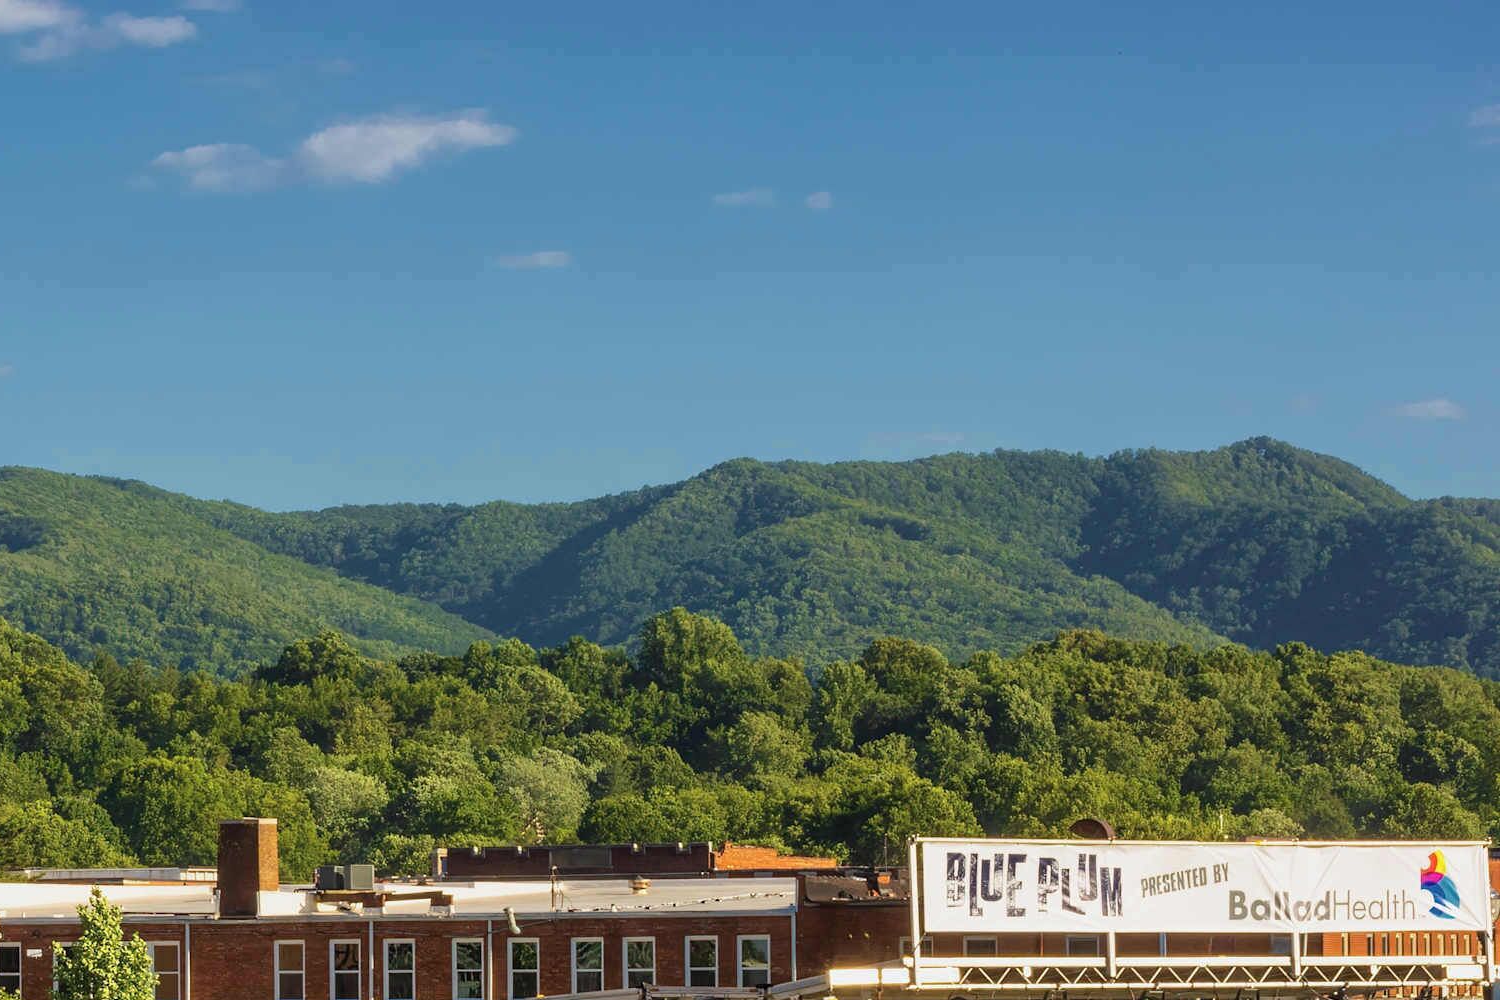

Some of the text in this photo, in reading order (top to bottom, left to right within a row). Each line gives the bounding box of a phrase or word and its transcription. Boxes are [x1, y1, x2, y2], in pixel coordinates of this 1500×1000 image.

[946, 852, 1123, 917] BLUE PLUM
[1141, 862, 1229, 898] PRESENTED BY
